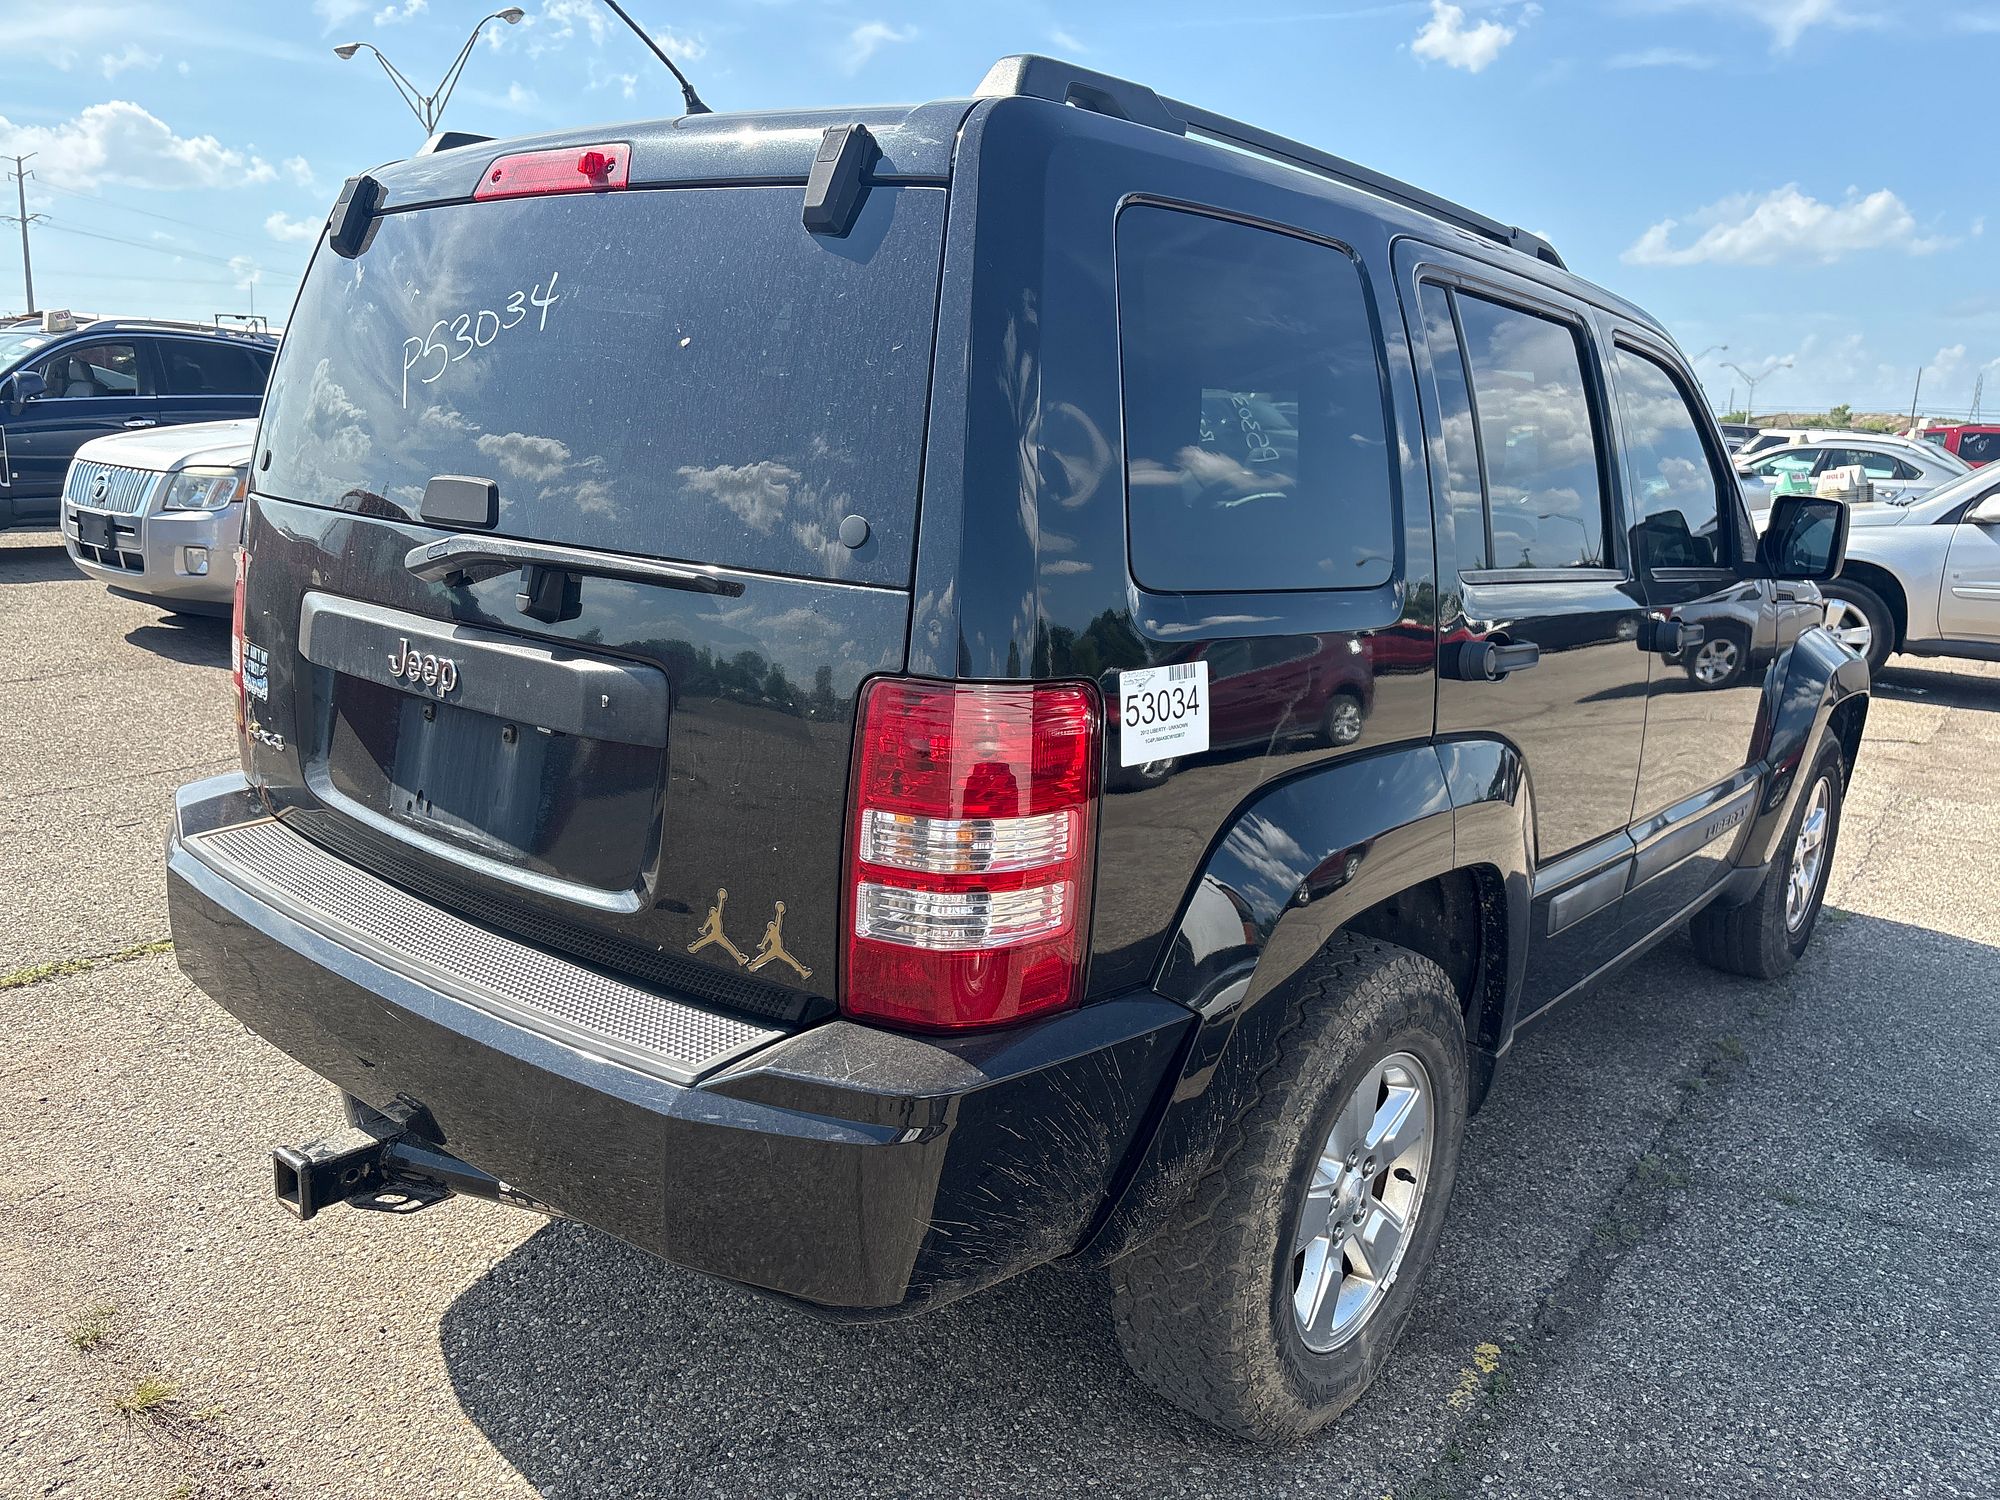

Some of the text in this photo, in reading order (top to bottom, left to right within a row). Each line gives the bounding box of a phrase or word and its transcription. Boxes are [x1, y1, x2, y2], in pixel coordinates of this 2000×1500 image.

[402, 271, 560, 410] P53034
[388, 637, 458, 698] Jeep
[1125, 685, 1200, 727] 53034
[1150, 726, 1166, 734] LIBERTY
[1705, 804, 1749, 840] LIBERTY
